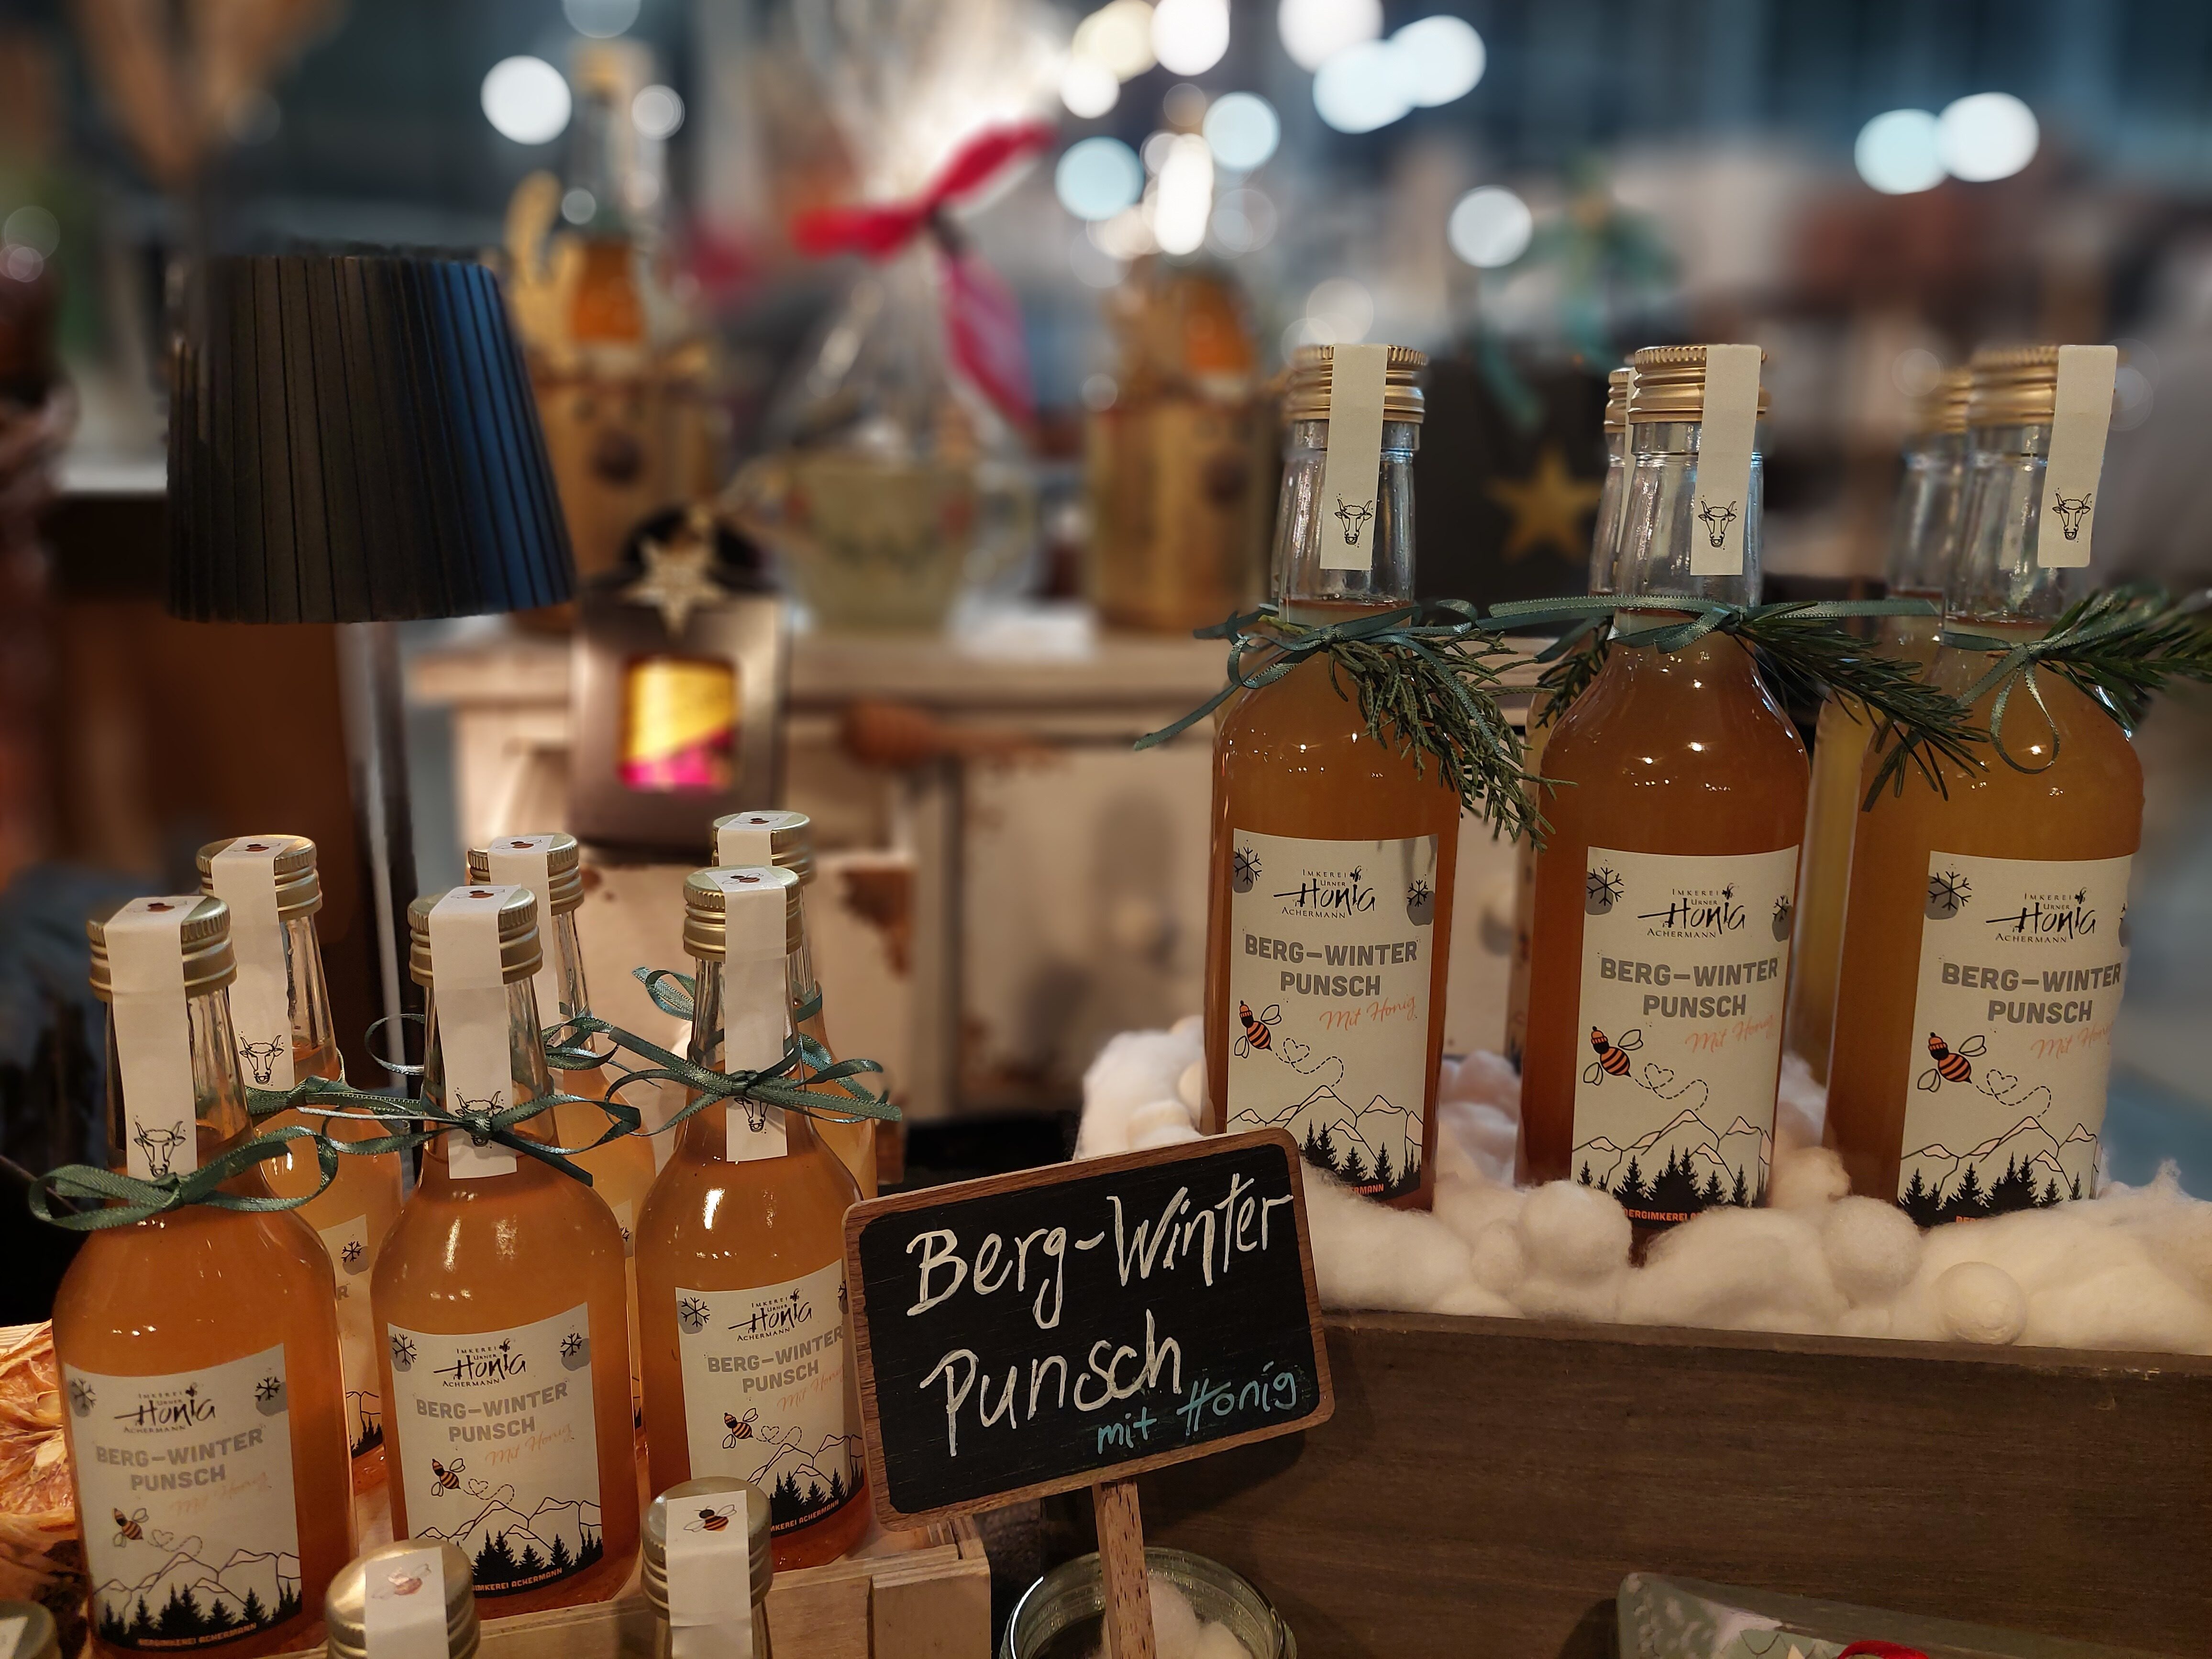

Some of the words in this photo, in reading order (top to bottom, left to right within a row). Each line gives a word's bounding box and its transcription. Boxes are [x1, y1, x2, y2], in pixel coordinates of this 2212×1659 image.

[1303, 869, 1346, 878] IMKEREI
[1282, 907, 1346, 918] ACHERMANN
[1647, 928, 1716, 938] ACHERMANN
[1995, 933, 2067, 943] ACHERMANN
[1281, 971, 1381, 996] PUNSCH
[1319, 1007, 1361, 1031] Mit
[1366, 996, 1415, 1022] Honig
[1643, 994, 1746, 1018] PUNSCH
[1988, 1000, 2092, 1024] PUNSCH
[1350, 1183, 1384, 1194] RMANN
[906, 1173, 1294, 1329] Berg-Winter
[752, 1297, 787, 1308] IMKEREI
[737, 1327, 789, 1341] ACHERMANN
[442, 1378, 499, 1387] ACHERMANN
[742, 1359, 818, 1393] PUNSCH
[919, 1309, 1181, 1457] Punsch
[1097, 1406, 1158, 1454] mit
[1177, 1360, 1297, 1436] Honig
[449, 1416, 535, 1442] PUNSCH
[485, 1445, 520, 1466] Mit
[131, 1464, 226, 1491] PUNSCH
[771, 1519, 797, 1532] MKEREI
[799, 1499, 839, 1524] ACHERMANN
[511, 1568, 562, 1587] ACHERMANN
